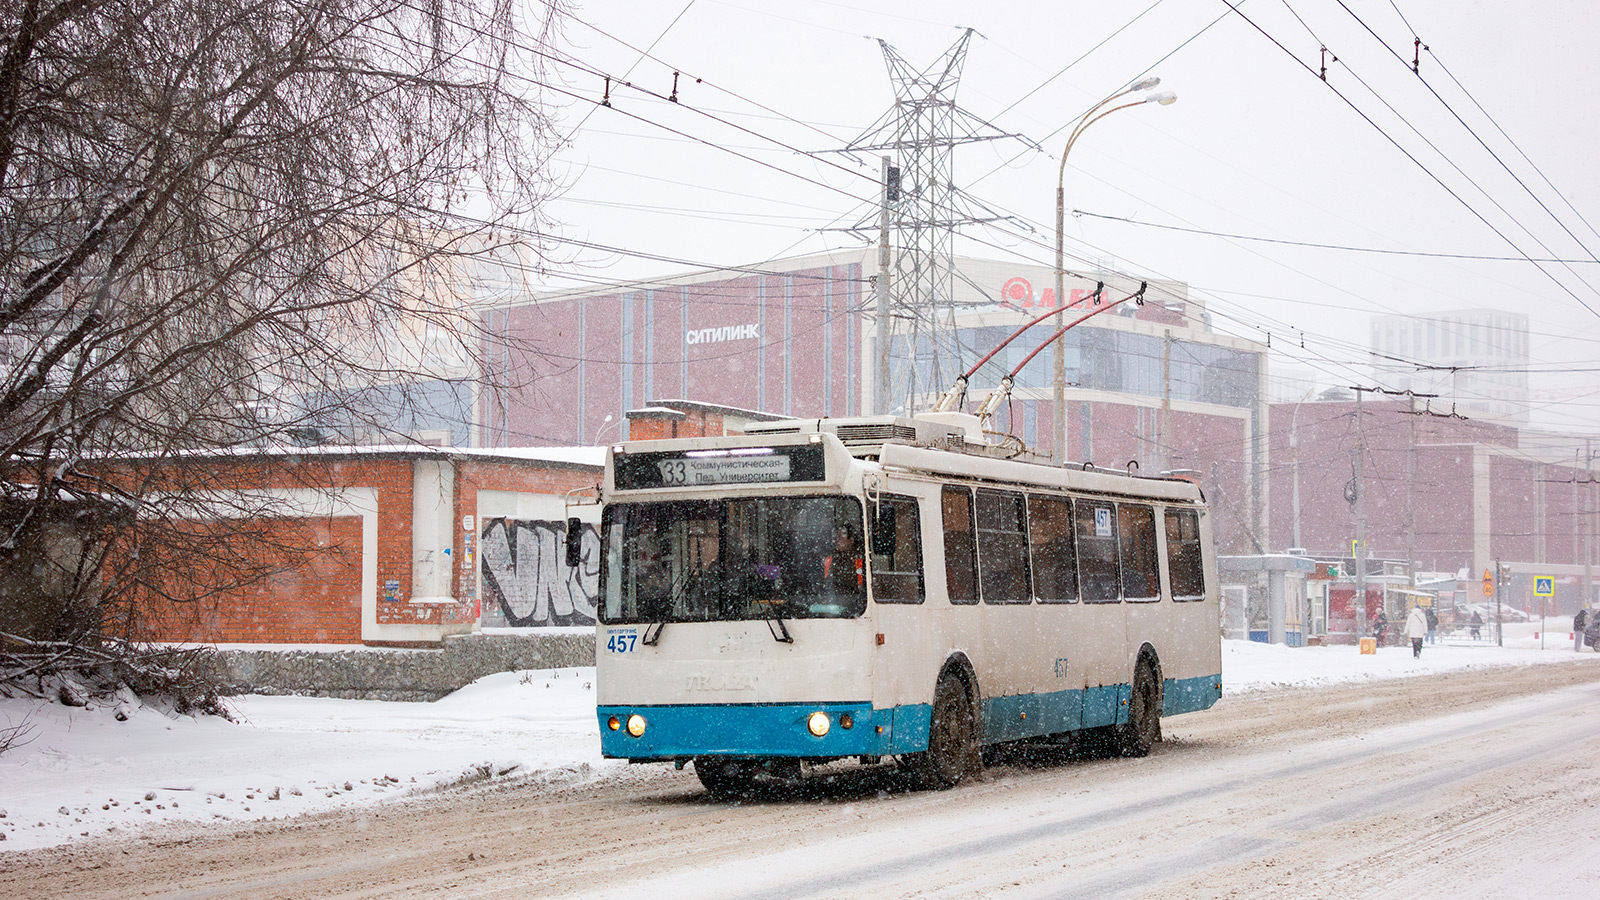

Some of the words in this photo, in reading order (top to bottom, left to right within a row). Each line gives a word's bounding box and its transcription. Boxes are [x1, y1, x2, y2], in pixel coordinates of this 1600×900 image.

[686, 323, 760, 345] СИТИЛИНК
[664, 461, 686, 484] 33
[695, 472, 716, 483] Пед.
[719, 472, 779, 481] Университет
[1096, 510, 1108, 527] 457
[607, 635, 638, 653] 457
[1054, 658, 1068, 678] 457
